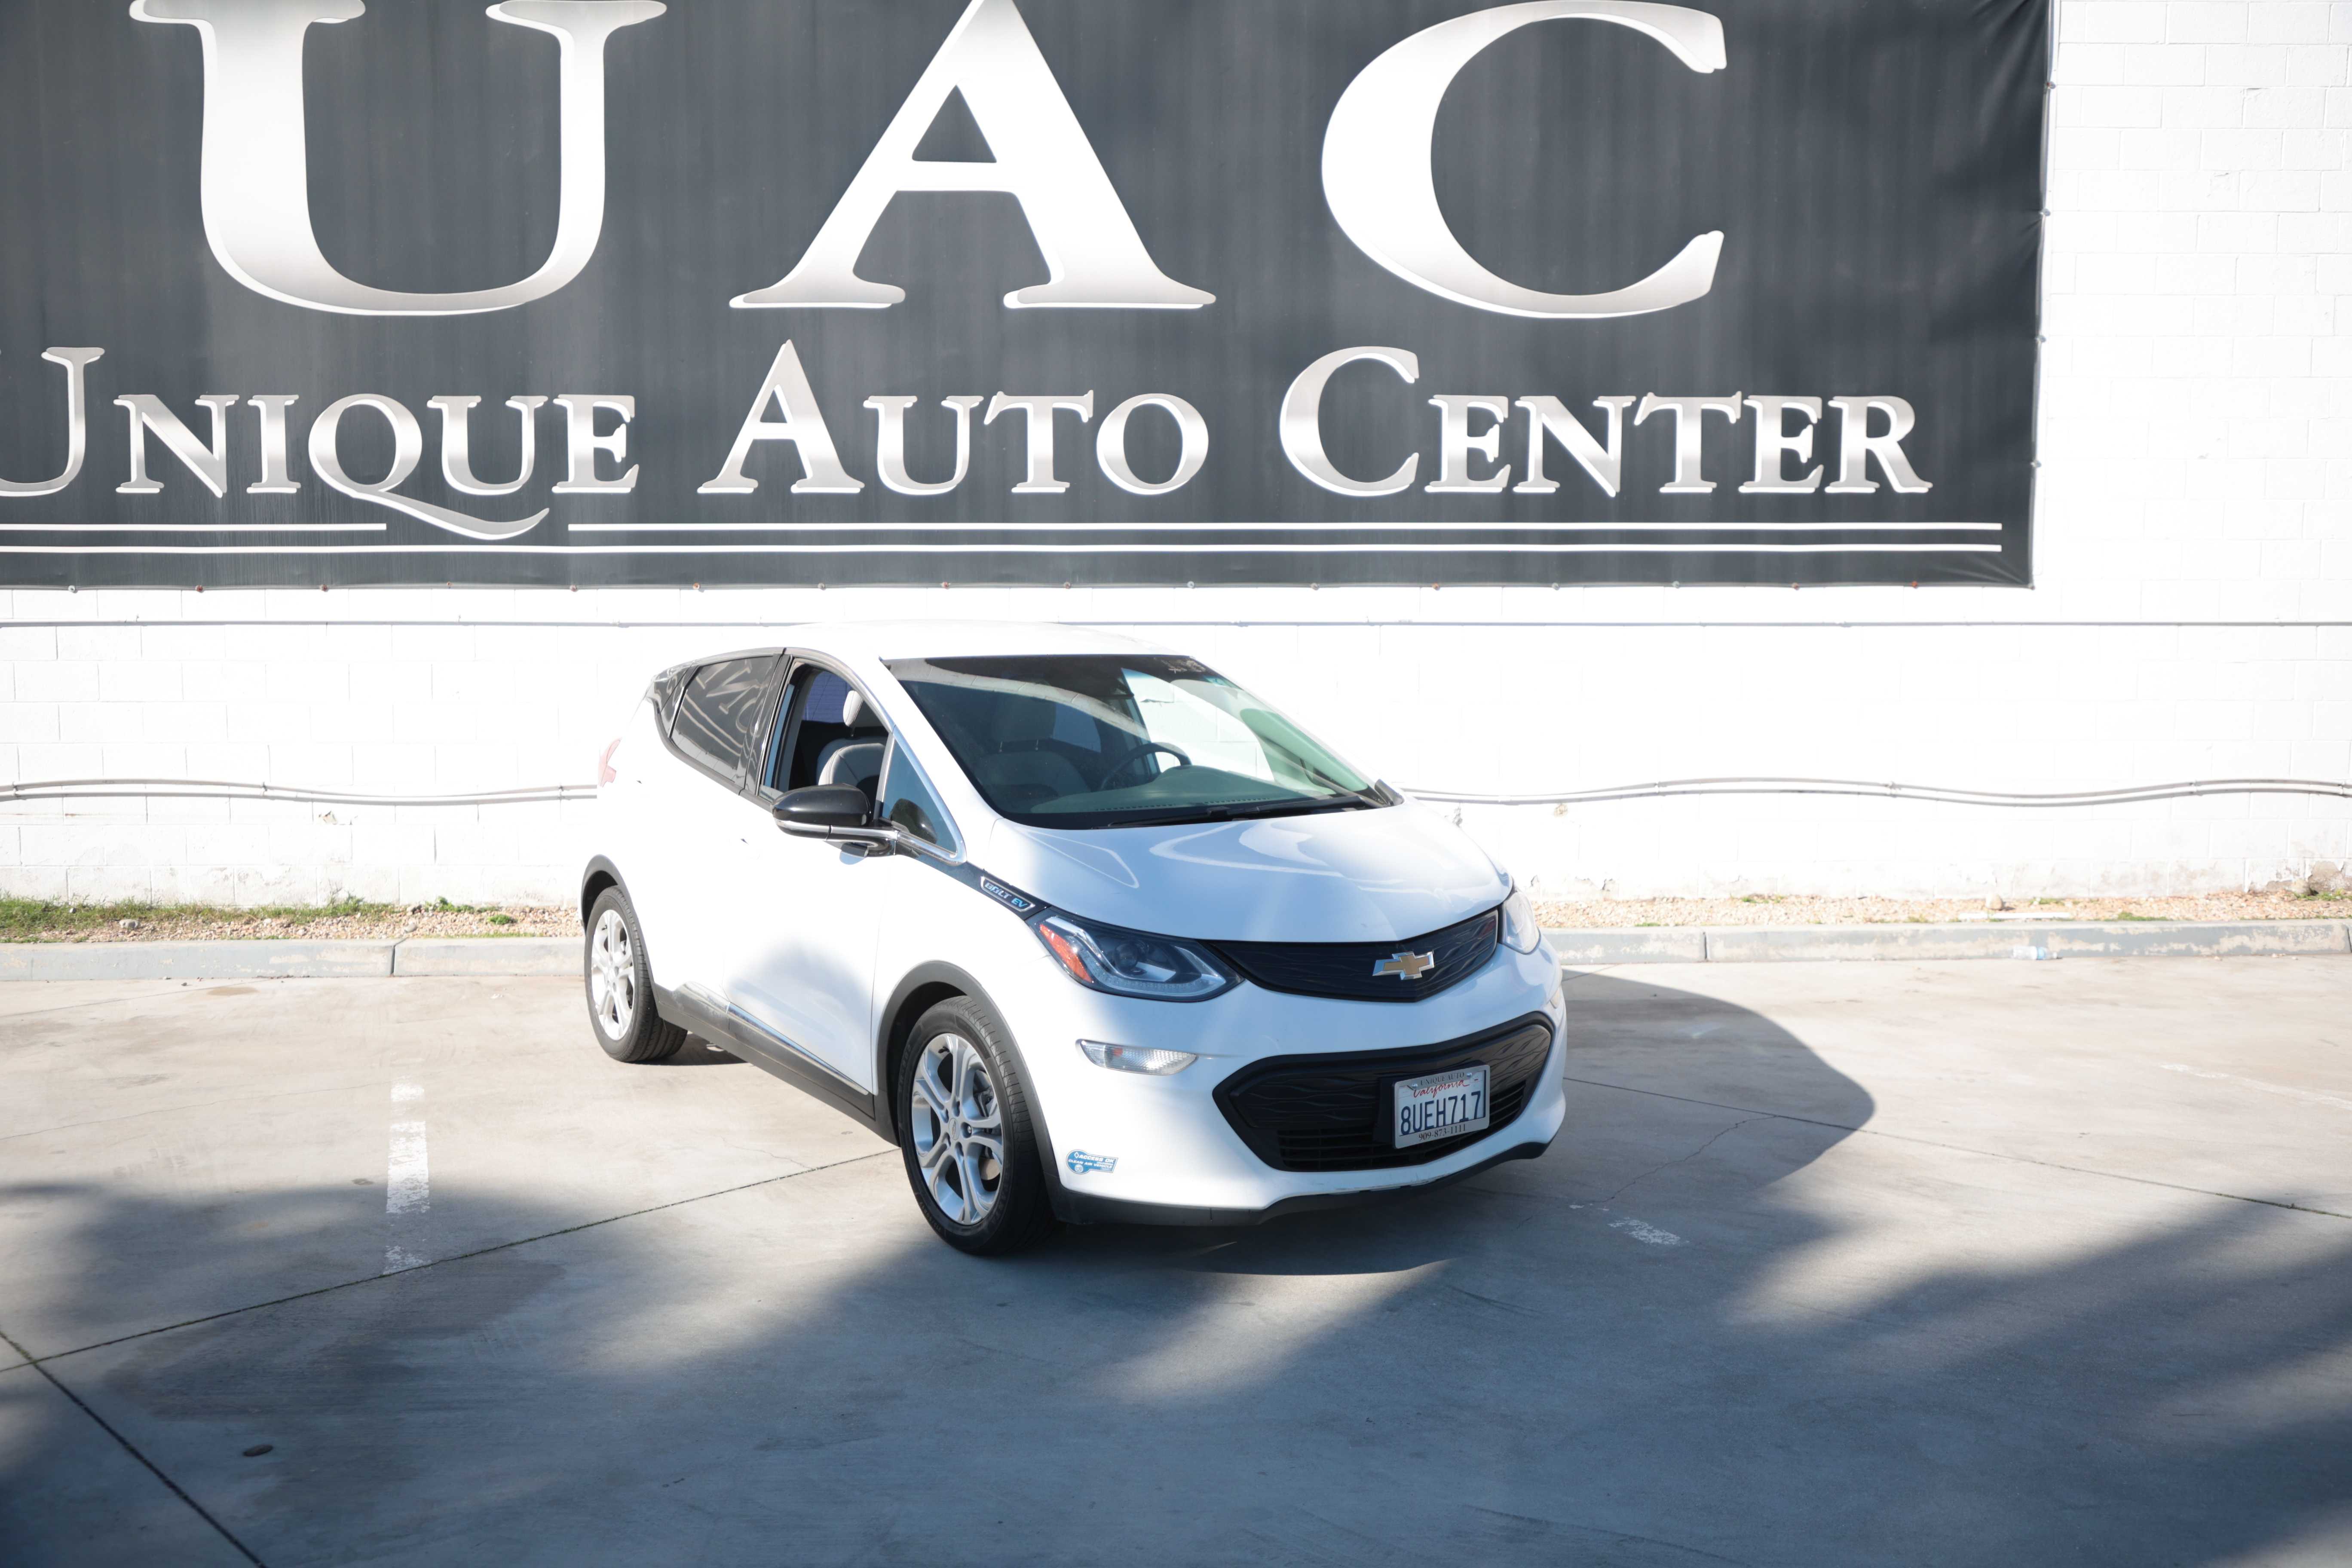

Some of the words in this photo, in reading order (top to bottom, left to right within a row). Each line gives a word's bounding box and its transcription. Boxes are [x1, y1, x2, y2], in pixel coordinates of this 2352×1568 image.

[129, 0, 1727, 319] UAC
[697, 339, 1209, 496] AUTO
[1279, 346, 1933, 497] CENTER
[985, 882, 1012, 899] BOLT
[1011, 898, 1027, 907] EV
[1401, 1090, 1481, 1135] 8UEH717
[1418, 1124, 1466, 1141] 909-873-1111
